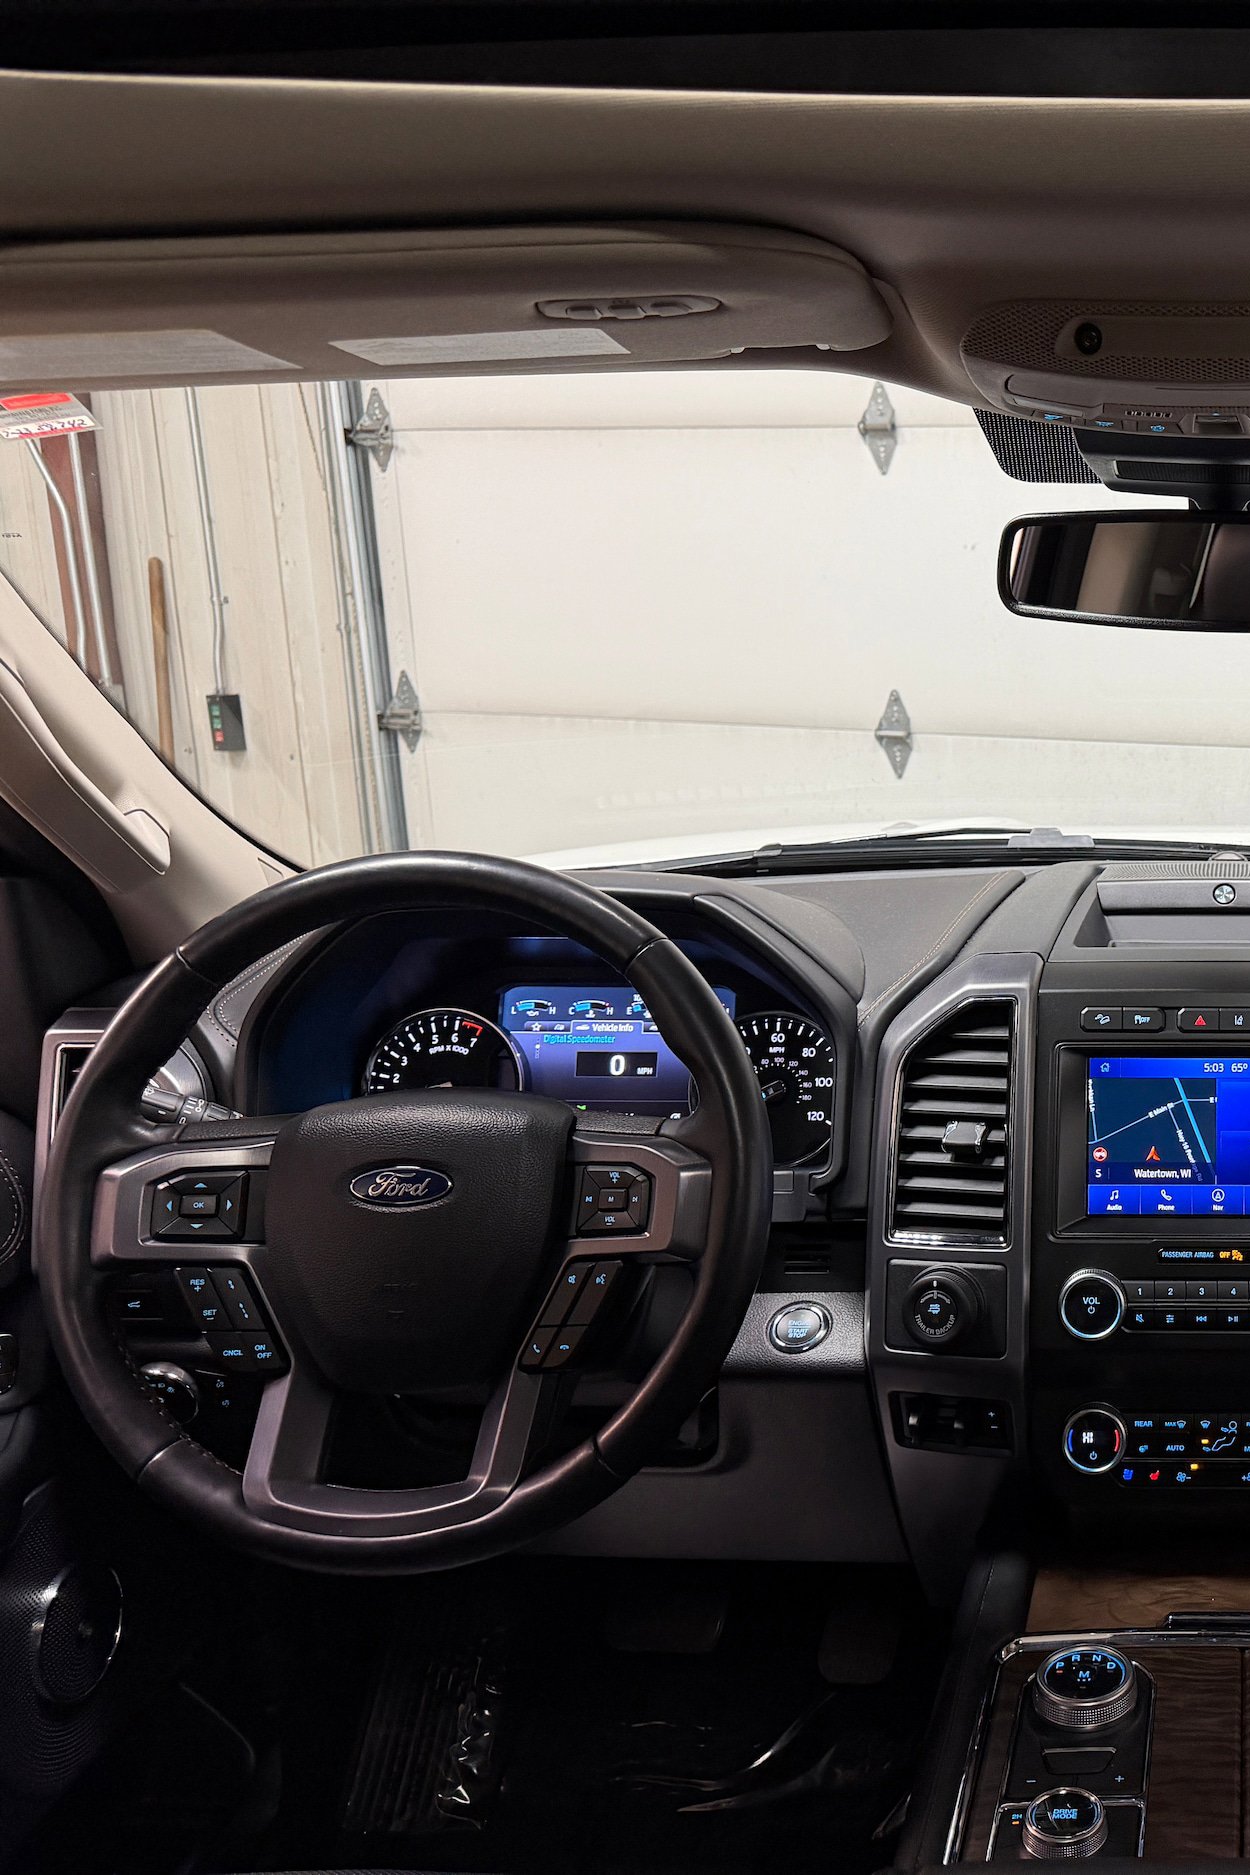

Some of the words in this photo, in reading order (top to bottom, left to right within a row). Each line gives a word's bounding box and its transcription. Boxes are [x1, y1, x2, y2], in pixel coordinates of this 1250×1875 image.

[549, 1007, 556, 1015] H
[569, 1007, 575, 1015] C
[606, 1007, 613, 1015] H
[626, 1007, 632, 1015] E
[592, 1023, 618, 1032] Vehicle
[618, 1023, 634, 1032] Info
[431, 1034, 439, 1044] 5
[451, 1033, 459, 1043] 6
[543, 1034, 567, 1044] Digital
[567, 1034, 616, 1044] Speedometer
[771, 1033, 785, 1043] 60
[413, 1043, 421, 1052] 4
[470, 1038, 478, 1048] 7
[429, 1045, 444, 1055] RPM
[452, 1045, 469, 1055] 1000
[802, 1047, 816, 1057] 80
[400, 1056, 408, 1066] 3
[609, 1054, 626, 1076] 0
[637, 1067, 653, 1075] MPH
[1203, 1063, 1224, 1073] 5:03
[392, 1073, 400, 1083] 2
[815, 1077, 833, 1087] 100
[807, 1111, 824, 1121] 120
[1095, 1168, 1102, 1178] S
[1134, 1168, 1180, 1179] Watertown,
[1180, 1168, 1192, 1178] WI
[368, 1171, 432, 1197] Ford
[189, 1278, 206, 1286] RES
[1167, 1287, 1174, 1296] 2
[1199, 1287, 1205, 1296] 3
[1230, 1287, 1237, 1296] 4
[1083, 1296, 1100, 1305] VOL
[1134, 1420, 1153, 1428] REAR
[1071, 1654, 1081, 1662] R
[1092, 1654, 1102, 1662] N
[1055, 1661, 1065, 1669] P
[1106, 1661, 1116, 1669] D
[1079, 1670, 1090, 1678] M
